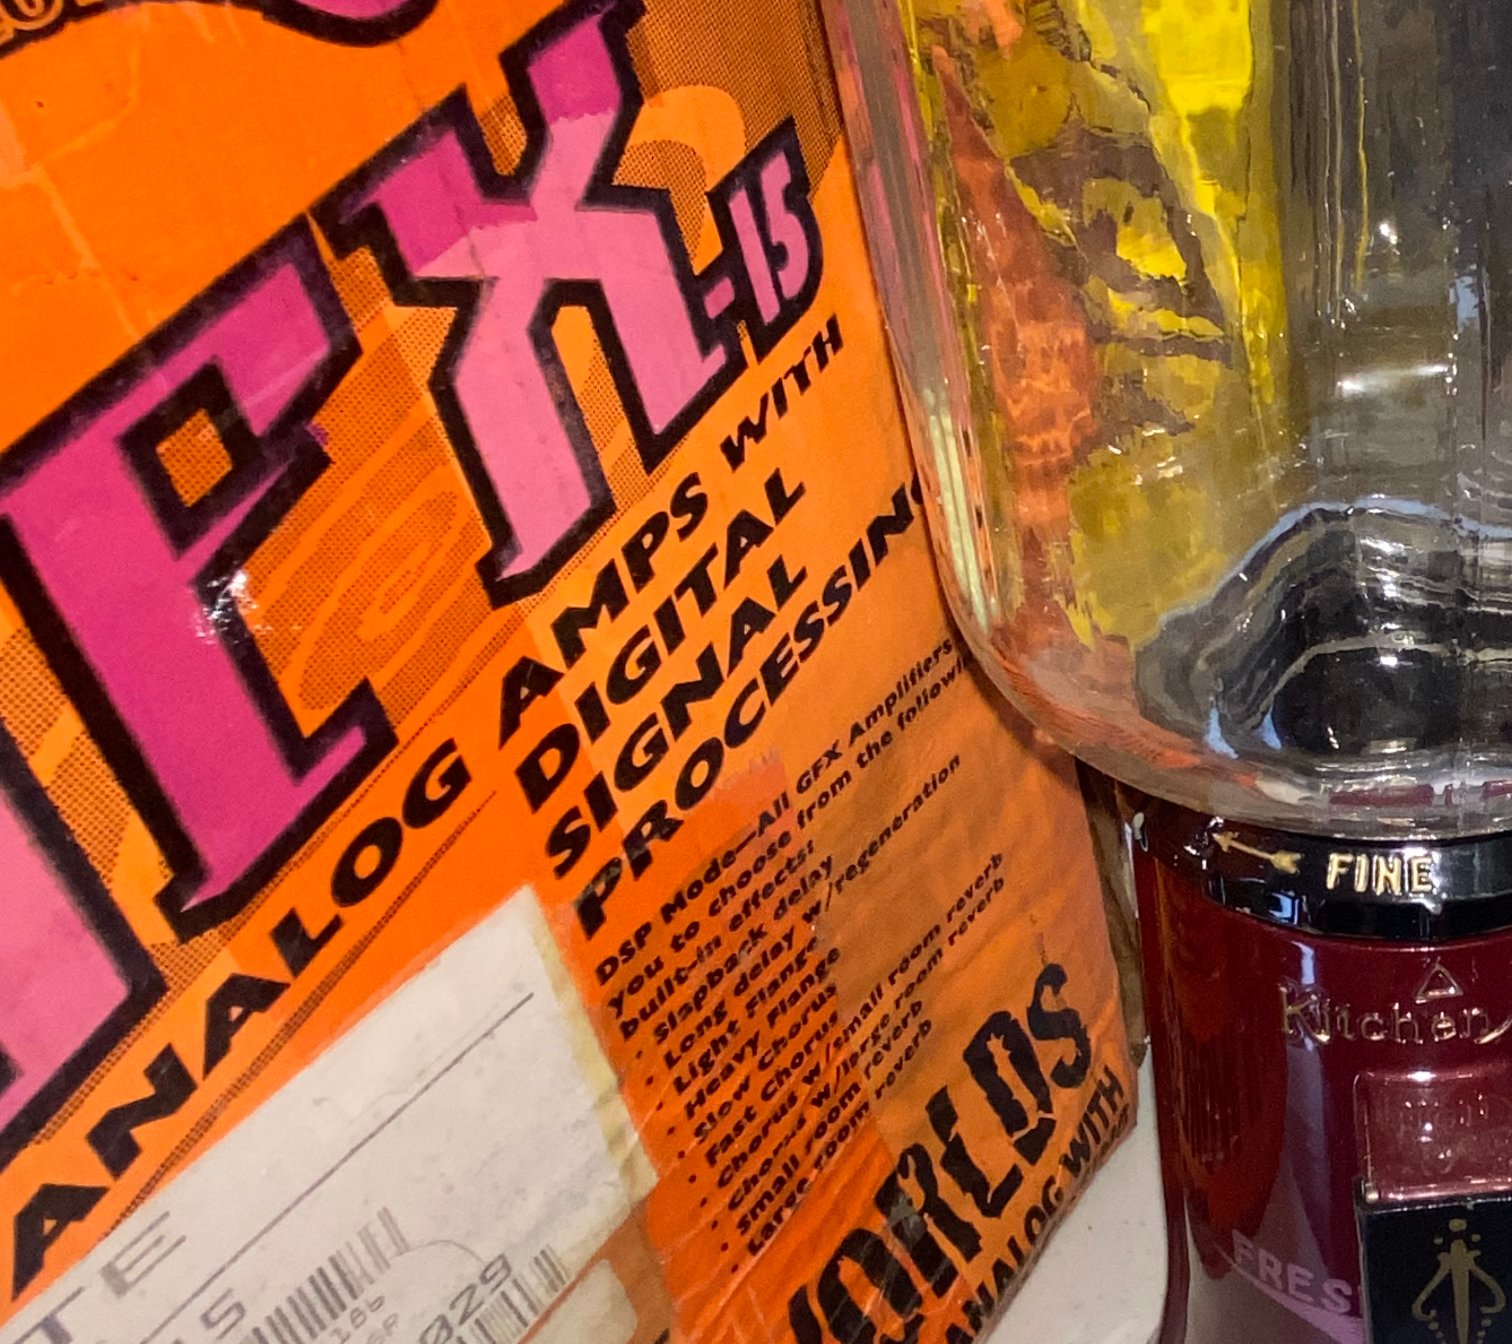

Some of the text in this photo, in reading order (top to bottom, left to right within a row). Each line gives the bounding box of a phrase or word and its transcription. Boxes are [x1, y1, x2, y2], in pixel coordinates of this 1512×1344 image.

[514, 467, 806, 814] DIGITAL
[543, 554, 807, 878] SIGNAL
[11, 312, 845, 1302] ANALOG AMPS WITH
[594, 922, 654, 986] DSP
[795, 739, 843, 795] GFX
[848, 638, 953, 749] Amplifiers
[607, 958, 665, 1019] you
[669, 920, 700, 954] to
[707, 829, 792, 919] choose
[797, 769, 853, 829] from
[855, 730, 893, 770] the
[1325, 850, 1438, 895] FINE
[619, 839, 815, 1042] built-in effects:
[652, 854, 834, 1045] Slapback delay
[663, 1000, 728, 1070] Long
[733, 926, 796, 997] delay
[672, 936, 818, 1096] Light Flange
[717, 852, 1005, 1189] Chorus w/small room reverb
[892, 944, 944, 1012] room
[946, 874, 1006, 948] reverb
[684, 947, 841, 1121] Heavy Flange
[693, 982, 838, 1144] Slow Chorus
[705, 1010, 839, 1169] Fast Chorus
[736, 996, 925, 1237] Small room reverb
[812, 1100, 870, 1173] room
[873, 1015, 933, 1100] reverb
[1059, 1064, 1125, 1178] WITH
[1230, 1227, 1364, 1318] FRES
